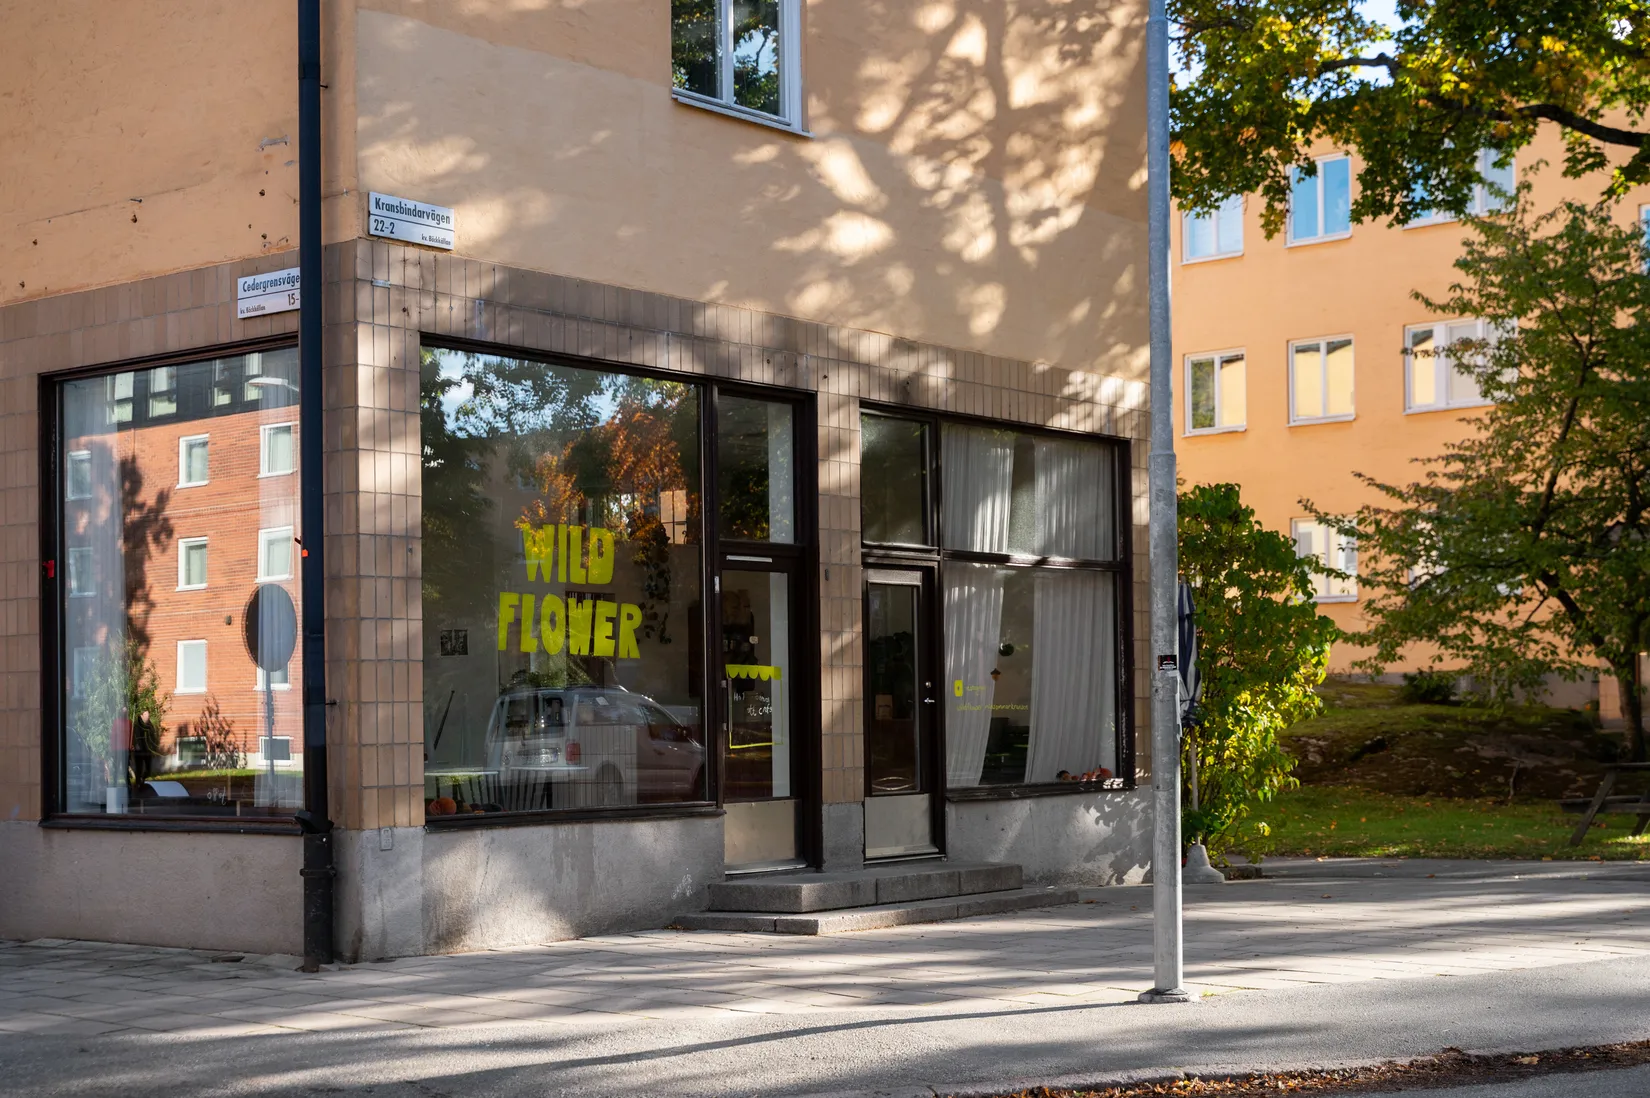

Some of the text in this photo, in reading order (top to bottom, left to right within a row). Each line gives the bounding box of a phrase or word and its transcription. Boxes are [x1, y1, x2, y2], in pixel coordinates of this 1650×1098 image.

[374, 197, 451, 226] Kransbindarvägen
[373, 218, 395, 235] 22-2
[242, 273, 300, 292] Cedergrensväge
[287, 292, 300, 306] 15-
[522, 523, 615, 585] WILD
[498, 592, 643, 659] FLOWER
